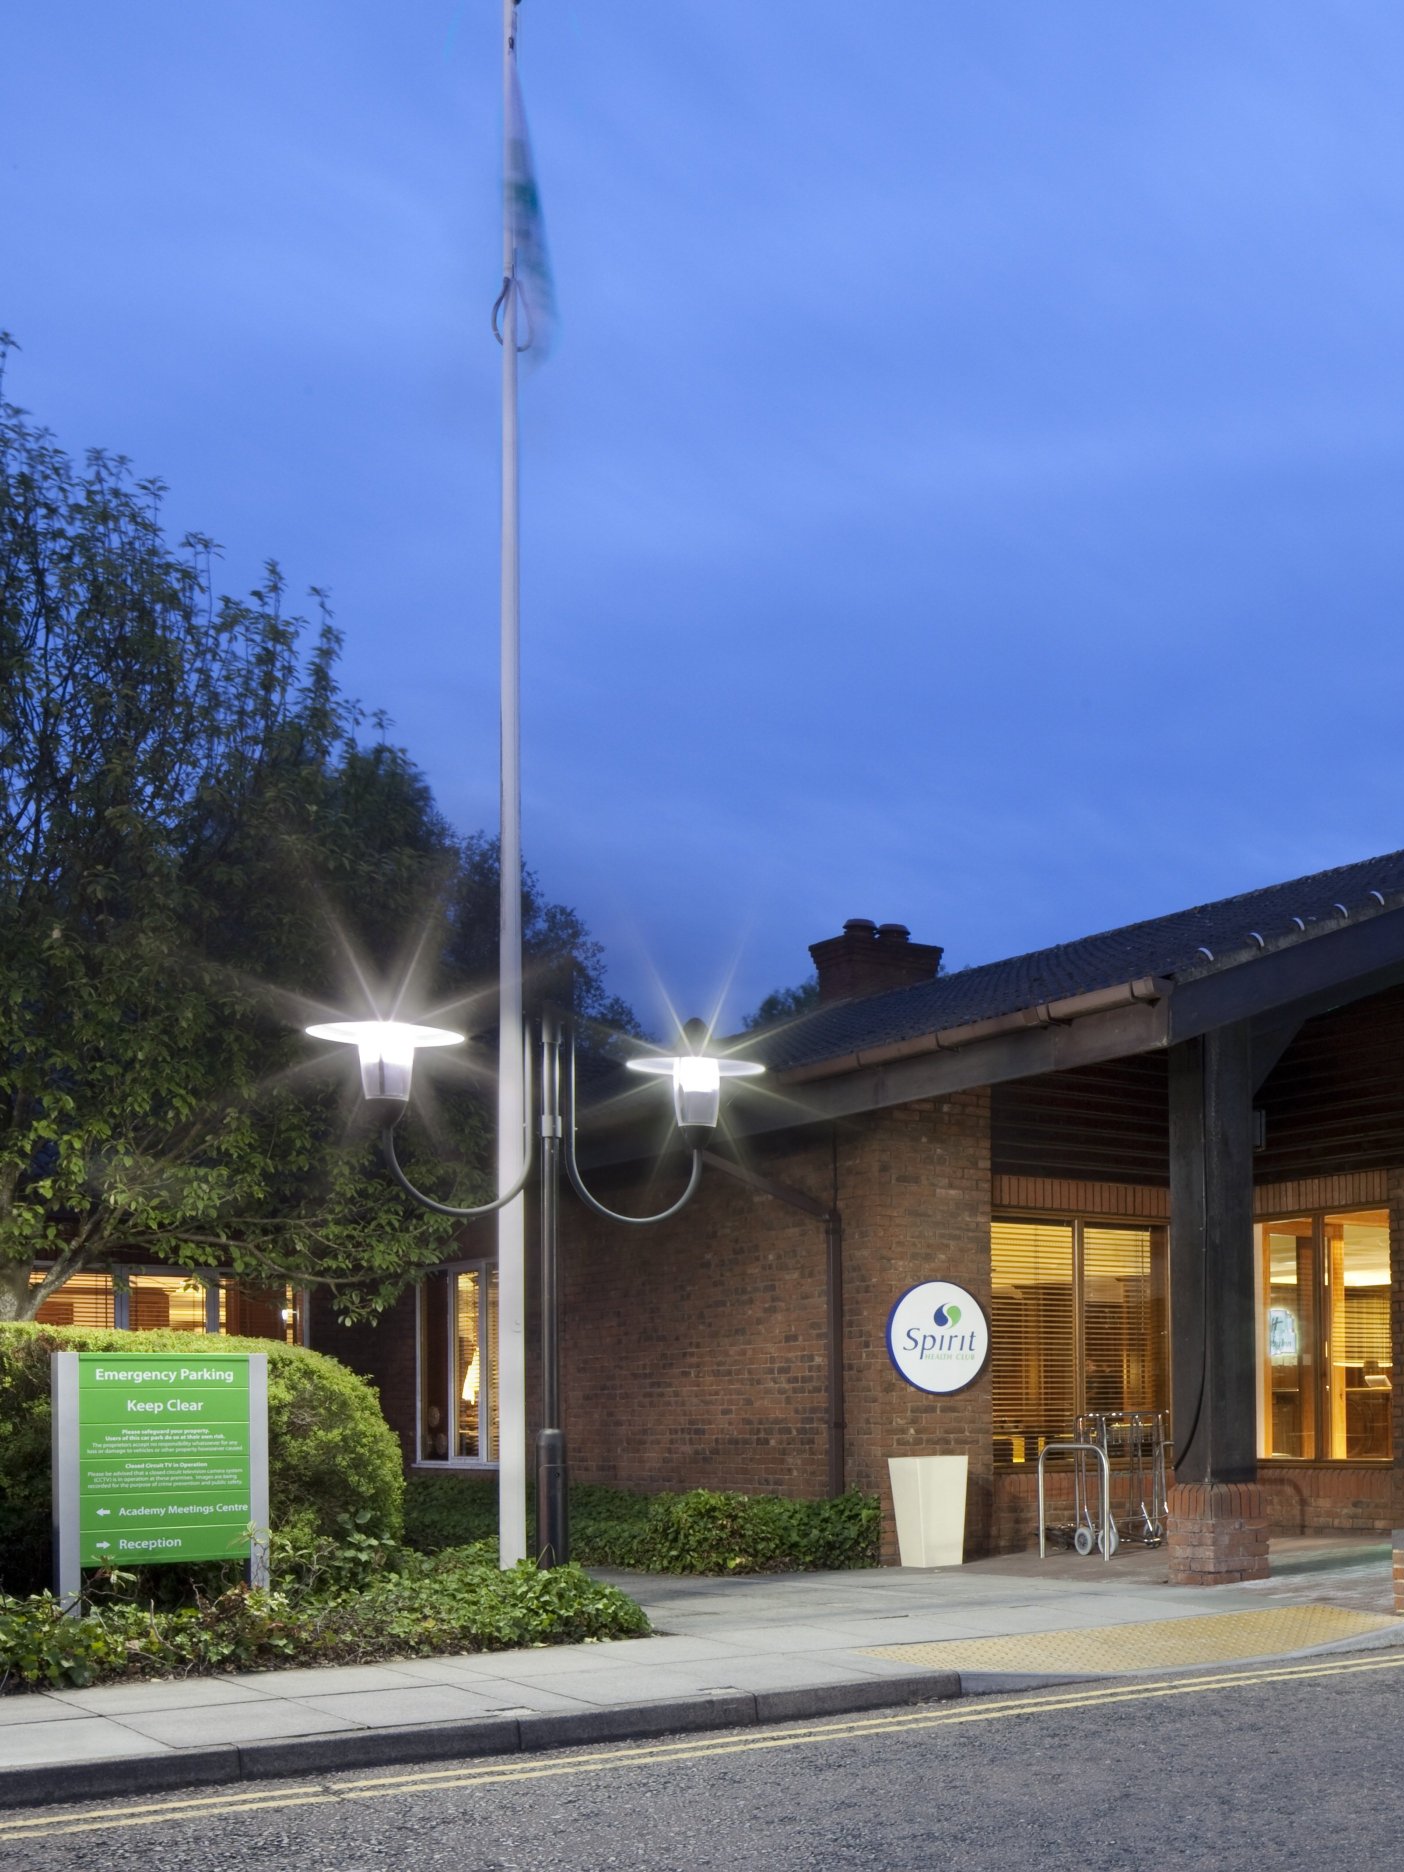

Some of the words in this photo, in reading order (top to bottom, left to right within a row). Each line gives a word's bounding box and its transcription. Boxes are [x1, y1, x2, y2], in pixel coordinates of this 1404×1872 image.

[903, 1328, 976, 1360] Spirit
[95, 1368, 177, 1383] Emergency
[180, 1368, 234, 1383] Parking
[127, 1400, 163, 1414] Keep
[167, 1399, 203, 1411] Clear
[118, 1507, 166, 1518] Academy
[168, 1504, 214, 1515] Meetings
[216, 1503, 248, 1512] Centre
[119, 1538, 182, 1550] Reception
